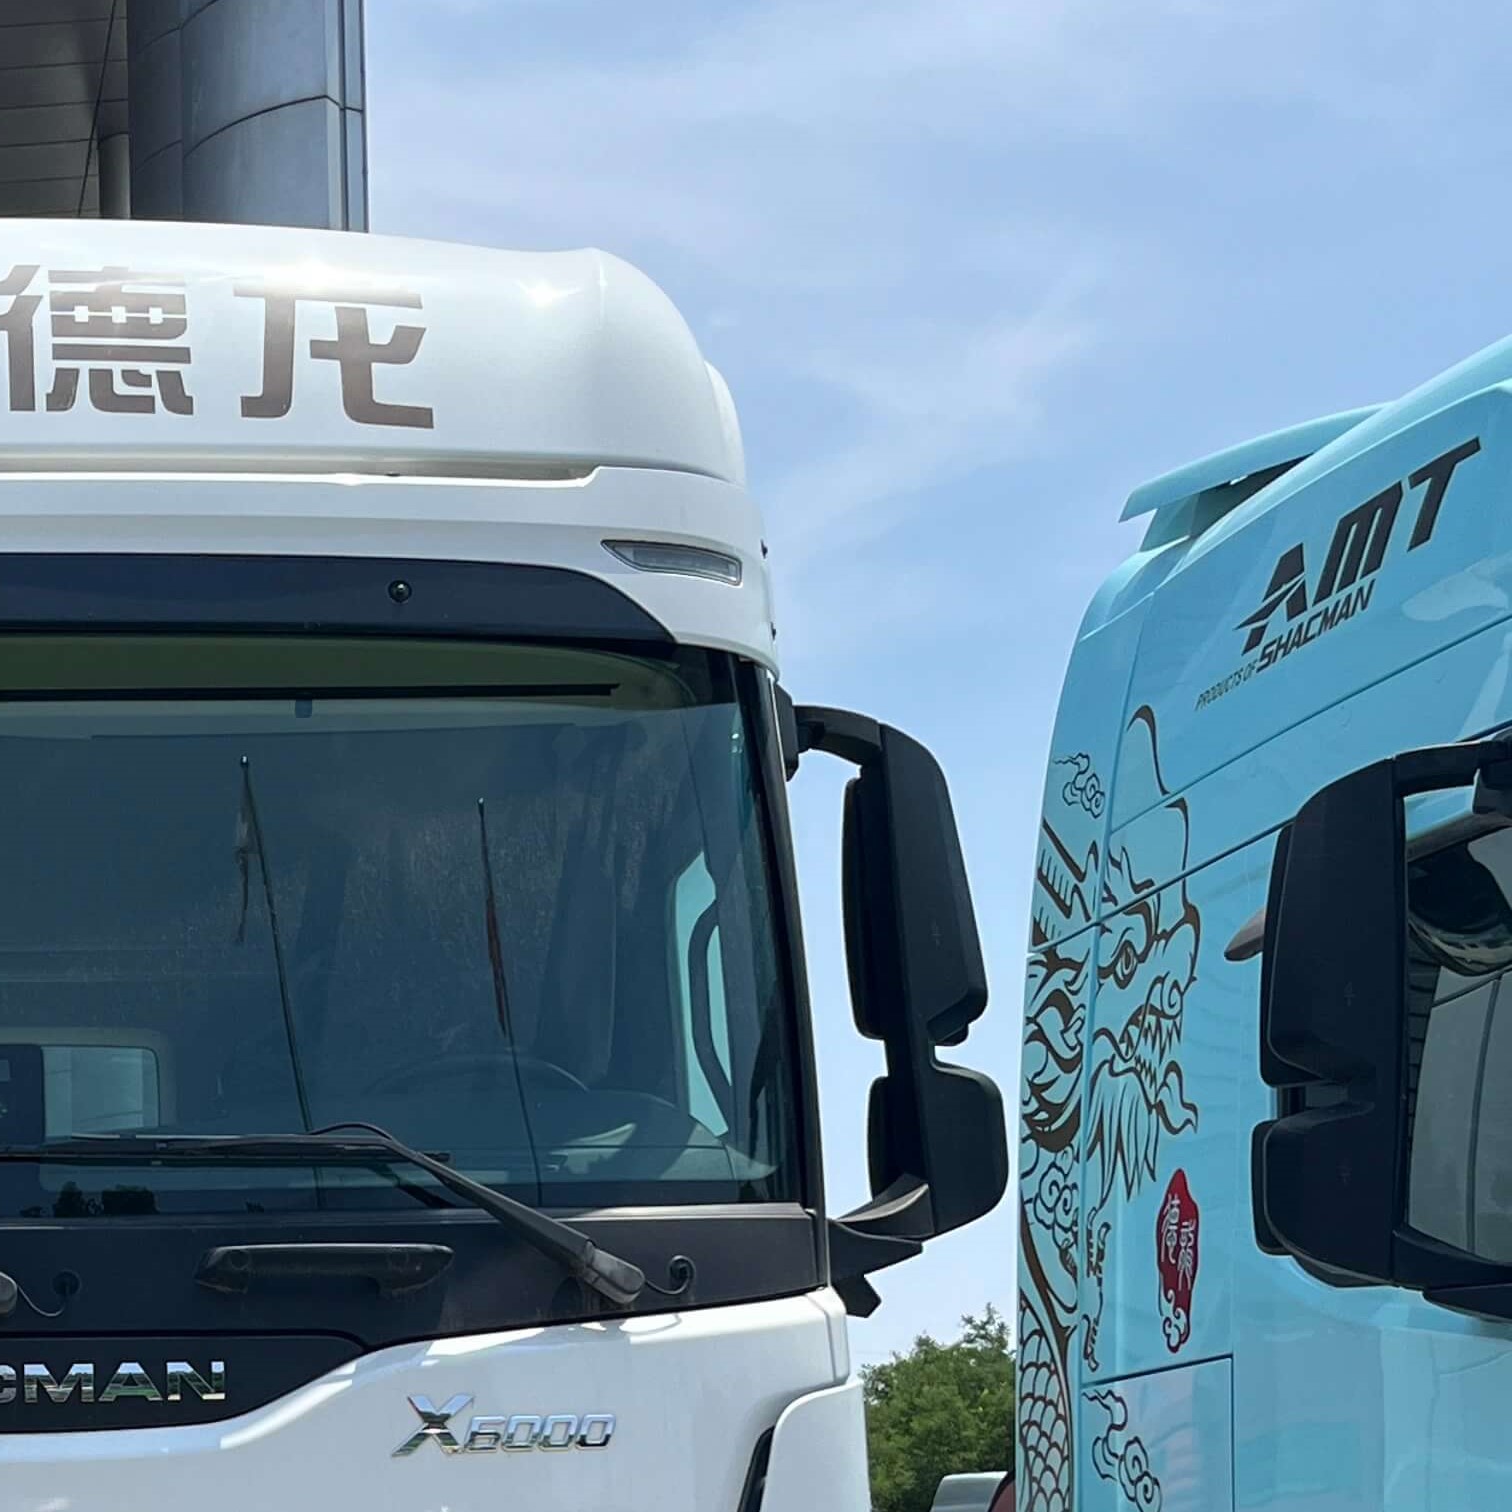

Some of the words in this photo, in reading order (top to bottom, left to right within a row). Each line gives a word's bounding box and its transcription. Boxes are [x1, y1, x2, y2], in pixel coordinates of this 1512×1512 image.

[1233, 436, 1482, 657] AMT
[1256, 578, 1376, 674] SHACMAN
[390, 1392, 618, 1459] X6000
